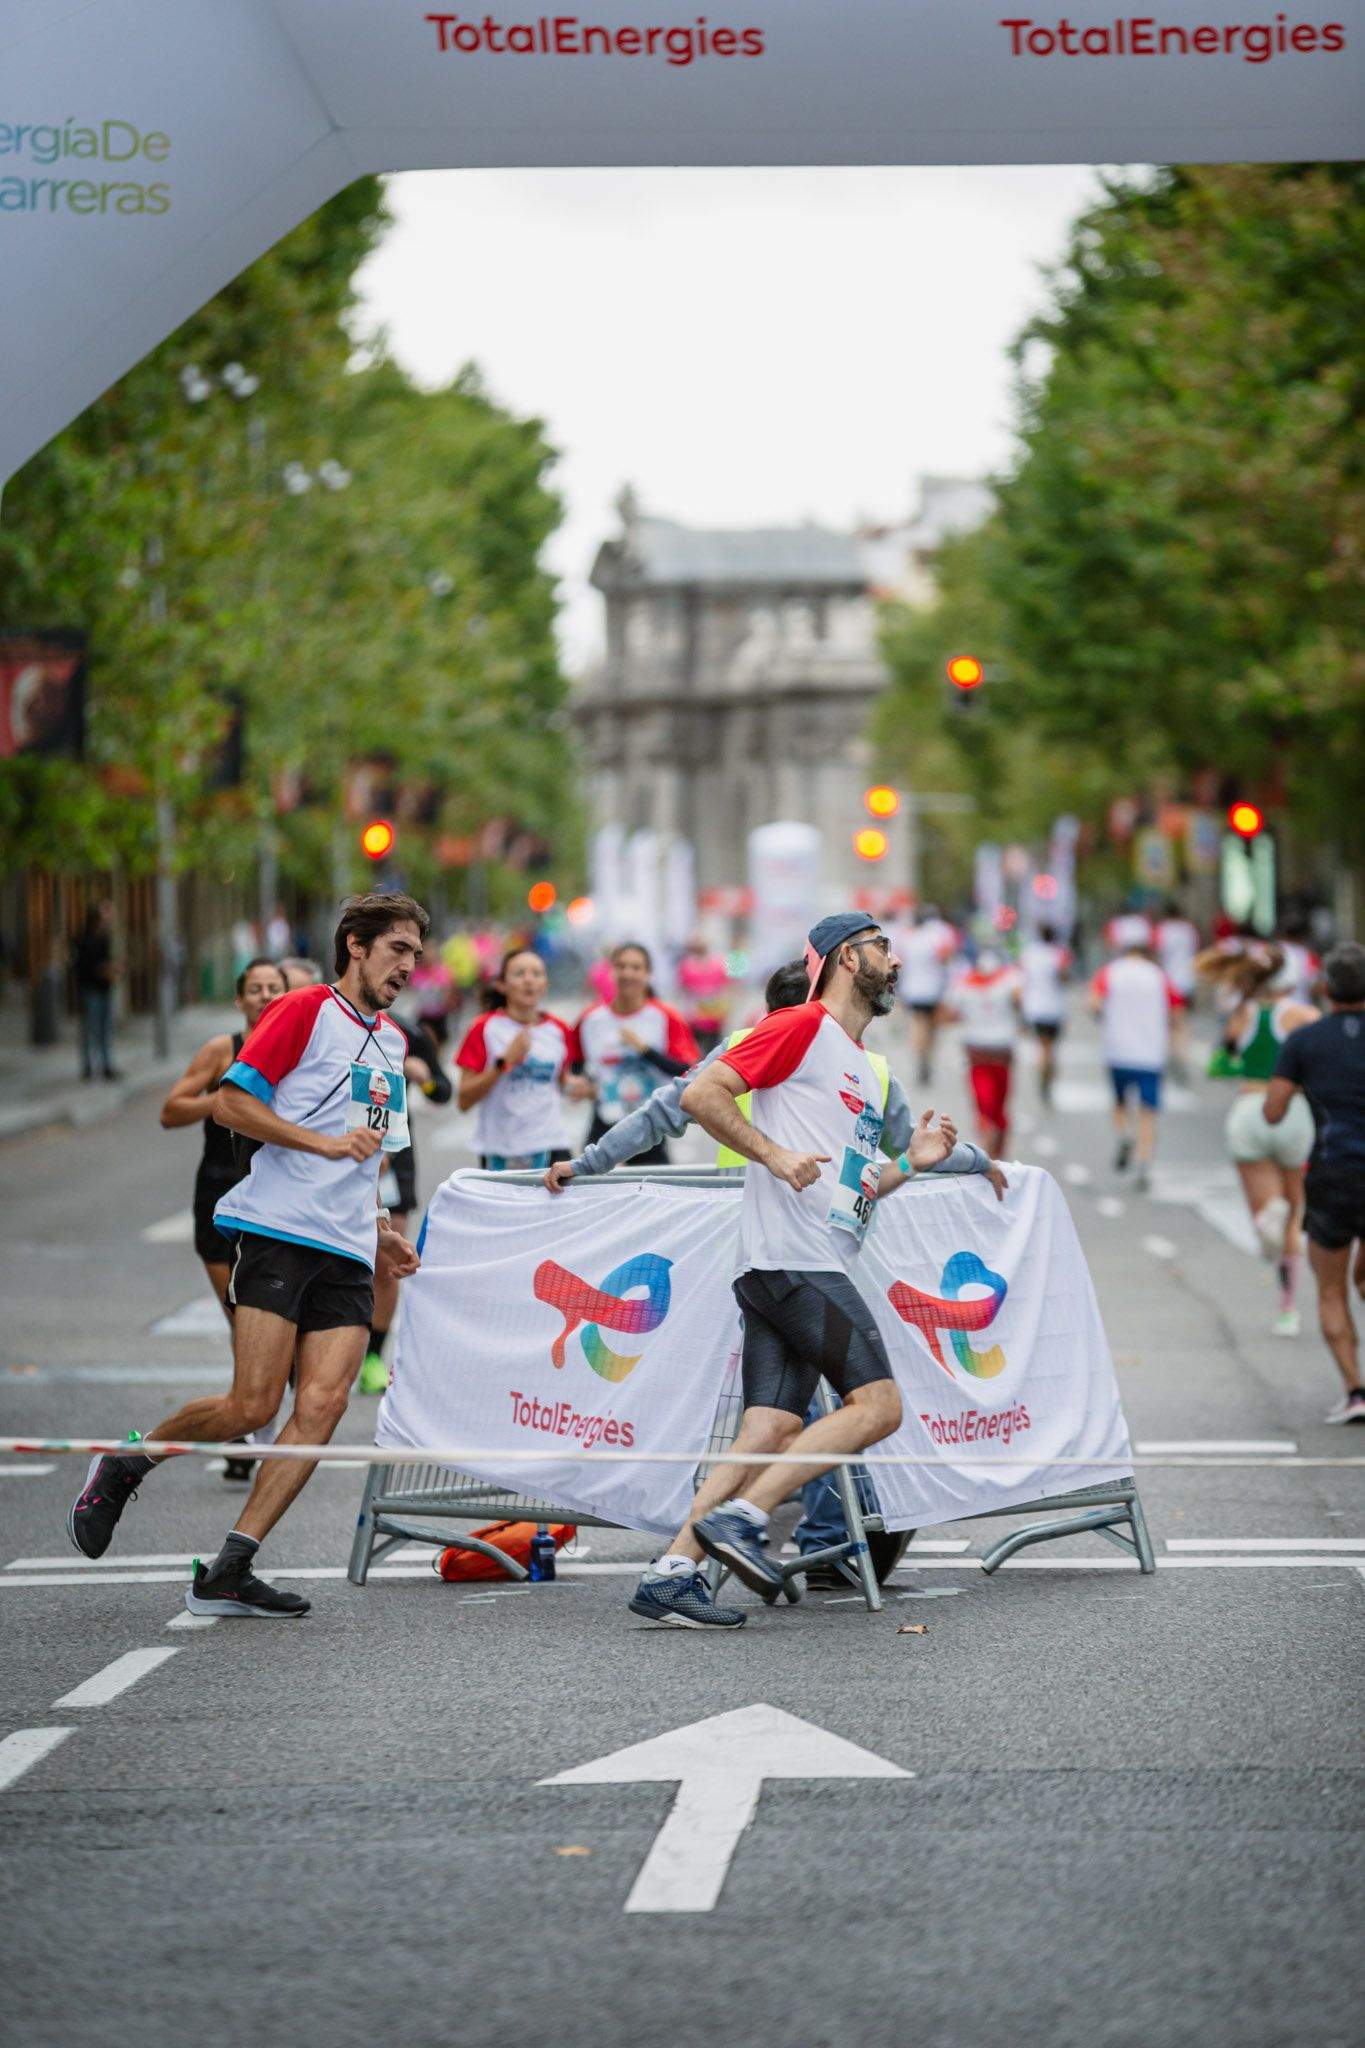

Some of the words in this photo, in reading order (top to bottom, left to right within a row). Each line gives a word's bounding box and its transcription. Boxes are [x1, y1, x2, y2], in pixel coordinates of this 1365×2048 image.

[426, 13, 764, 65] TotalEnergies
[1000, 13, 1345, 63] TotalEnergies
[0, 176, 171, 215] arreras
[366, 1106, 390, 1132] 124
[852, 1195, 873, 1225] 46
[510, 1390, 634, 1448] TotalEnergies
[920, 1400, 1030, 1444] TotalEnergies
